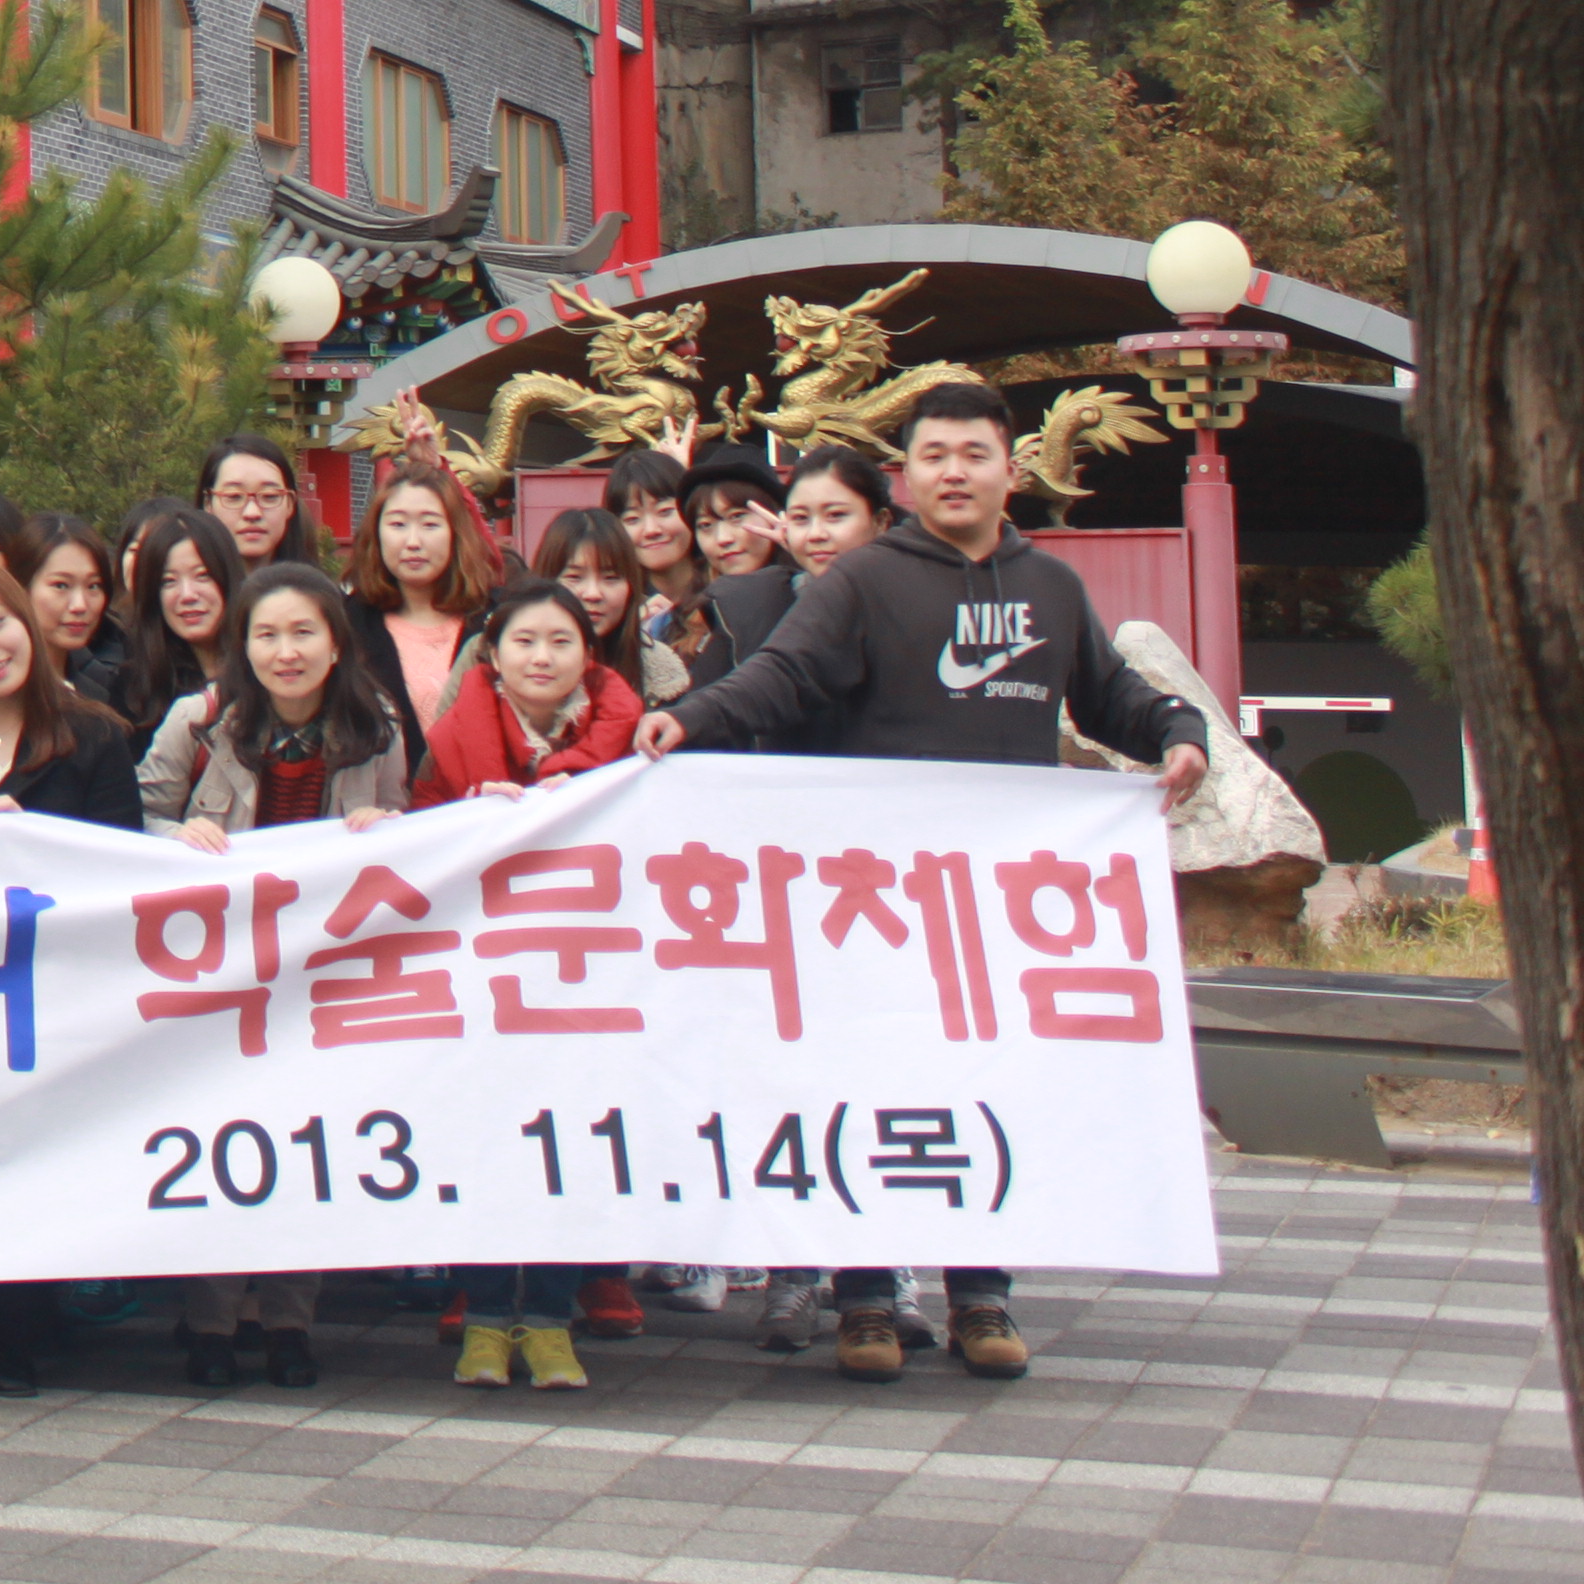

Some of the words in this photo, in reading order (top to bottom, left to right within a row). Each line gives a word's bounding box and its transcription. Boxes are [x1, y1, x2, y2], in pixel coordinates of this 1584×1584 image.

[486, 262, 654, 345] OUT
[956, 602, 1034, 645] NIKE
[142, 1108, 459, 1213] 2013.
